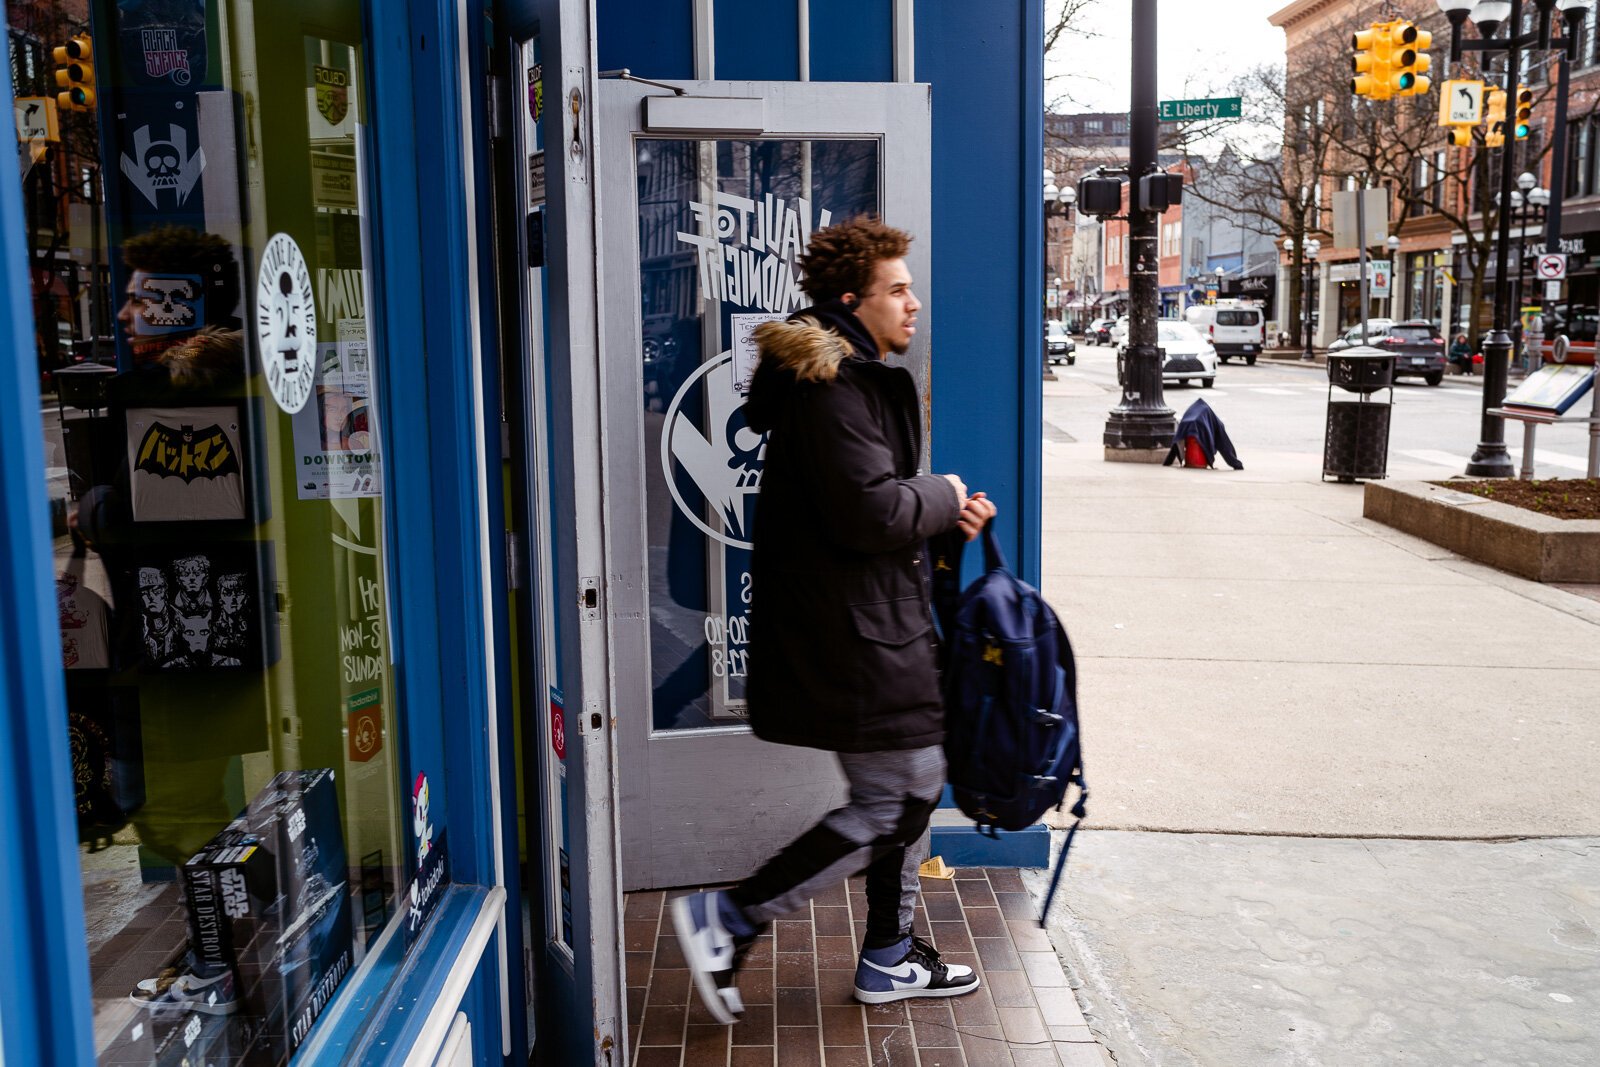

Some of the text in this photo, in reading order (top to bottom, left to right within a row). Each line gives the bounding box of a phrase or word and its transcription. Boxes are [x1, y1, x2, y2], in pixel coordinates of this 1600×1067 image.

[142, 29, 177, 51] BLACK
[145, 50, 189, 77] SCIENCE
[1176, 102, 1219, 118] Liberty
[1373, 262, 1390, 270] YAM
[138, 427, 230, 477] バットマン
[304, 453, 381, 466] DOWNTOW
[191, 870, 212, 903] STAR
[219, 868, 242, 918] WARS
[232, 868, 250, 915] STAR
[420, 855, 445, 906] tokidoki
[292, 1006, 314, 1048] STAR
[313, 949, 350, 1014] DESTROYER
